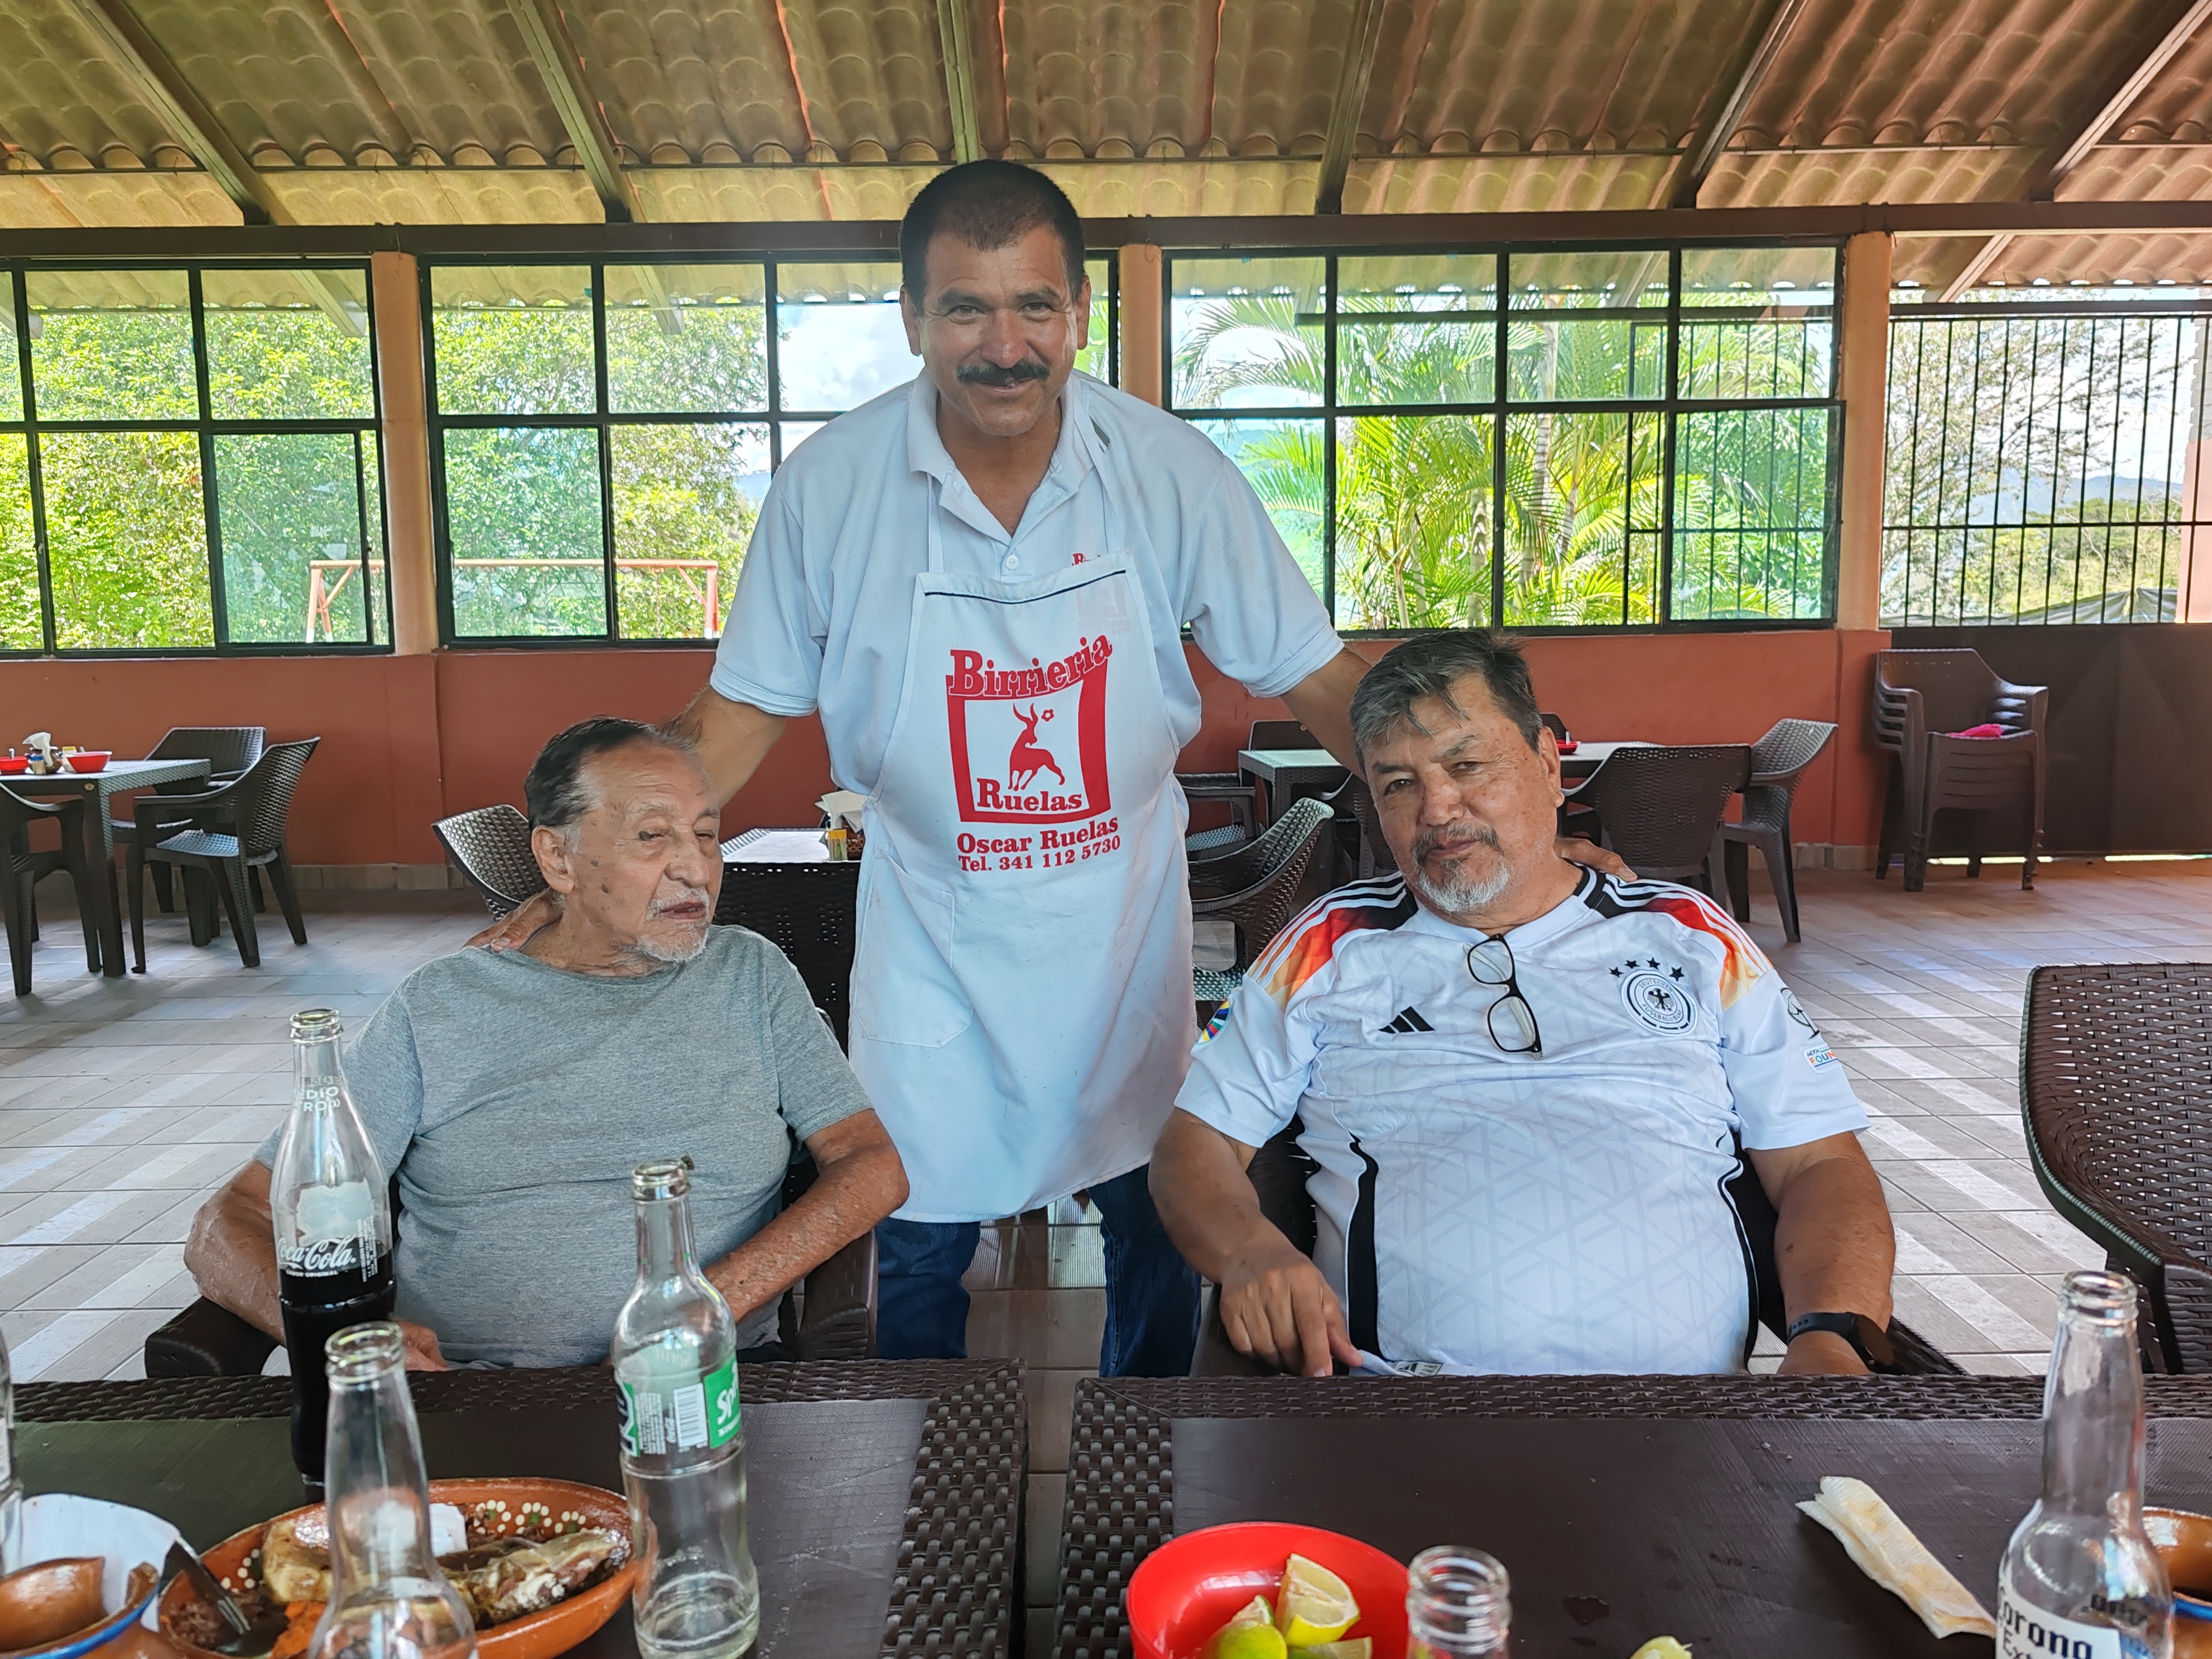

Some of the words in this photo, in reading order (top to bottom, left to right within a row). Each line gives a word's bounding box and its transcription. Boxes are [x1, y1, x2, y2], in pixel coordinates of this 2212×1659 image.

[949, 634, 1113, 697] Birrieria
[976, 777, 1083, 812] Ruelas
[957, 832, 1033, 855] Oscar
[1040, 816, 1119, 851] Ruelas
[958, 855, 992, 872] Tel.
[999, 855, 1034, 870] 341
[1042, 849, 1076, 866] 112
[1081, 835, 1121, 860] 5730
[1638, 979, 1674, 993] DEUTSCHER
[1807, 1049, 1820, 1057] UEFA
[1809, 1050, 1836, 1065] FOUN
[278, 1234, 357, 1270] Coca-Cola
[2000, 1602, 2093, 1659] orona
